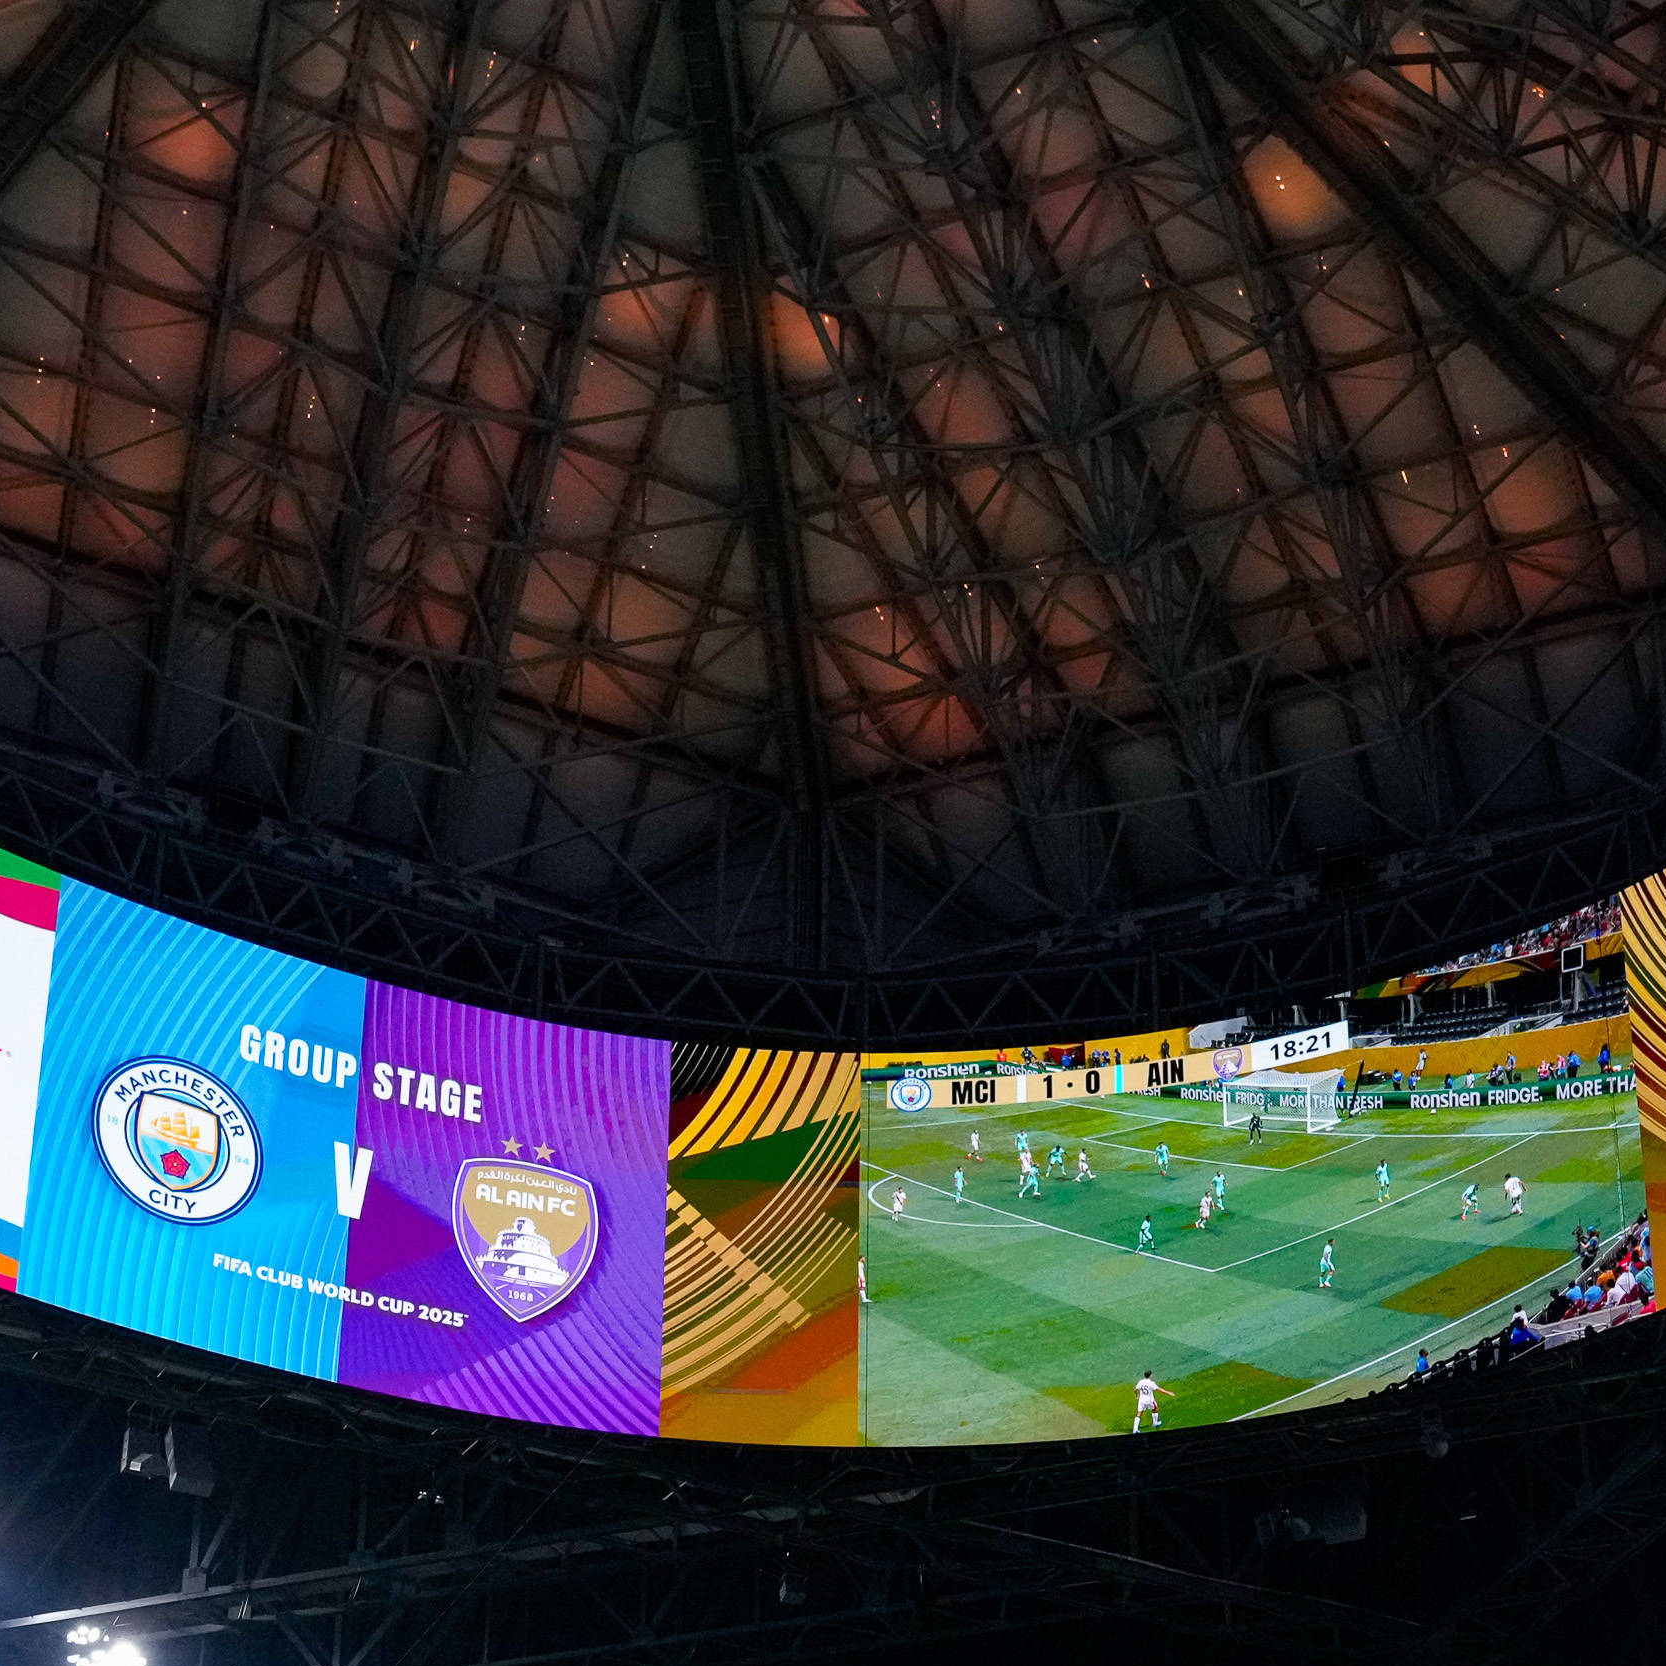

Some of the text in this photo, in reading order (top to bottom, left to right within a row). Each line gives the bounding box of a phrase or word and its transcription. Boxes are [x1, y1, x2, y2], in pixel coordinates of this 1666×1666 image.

[1270, 1030, 1333, 1061] 18:21
[239, 1024, 484, 1124] GROUP STAGE
[904, 1062, 980, 1080] Ronshen
[1147, 1060, 1185, 1088] AIN
[114, 1069, 246, 1139] MANCHESTER
[951, 1079, 997, 1105] MCI
[1409, 1089, 1481, 1109] Ronshen
[1556, 1081, 1604, 1101] MORE
[333, 1141, 374, 1220] V
[148, 1188, 197, 1214] CITY
[475, 1183, 576, 1217] AL AIN FC
[213, 1253, 416, 1316] FIFA CLUB WORLD CUP
[507, 1288, 535, 1303] 1968
